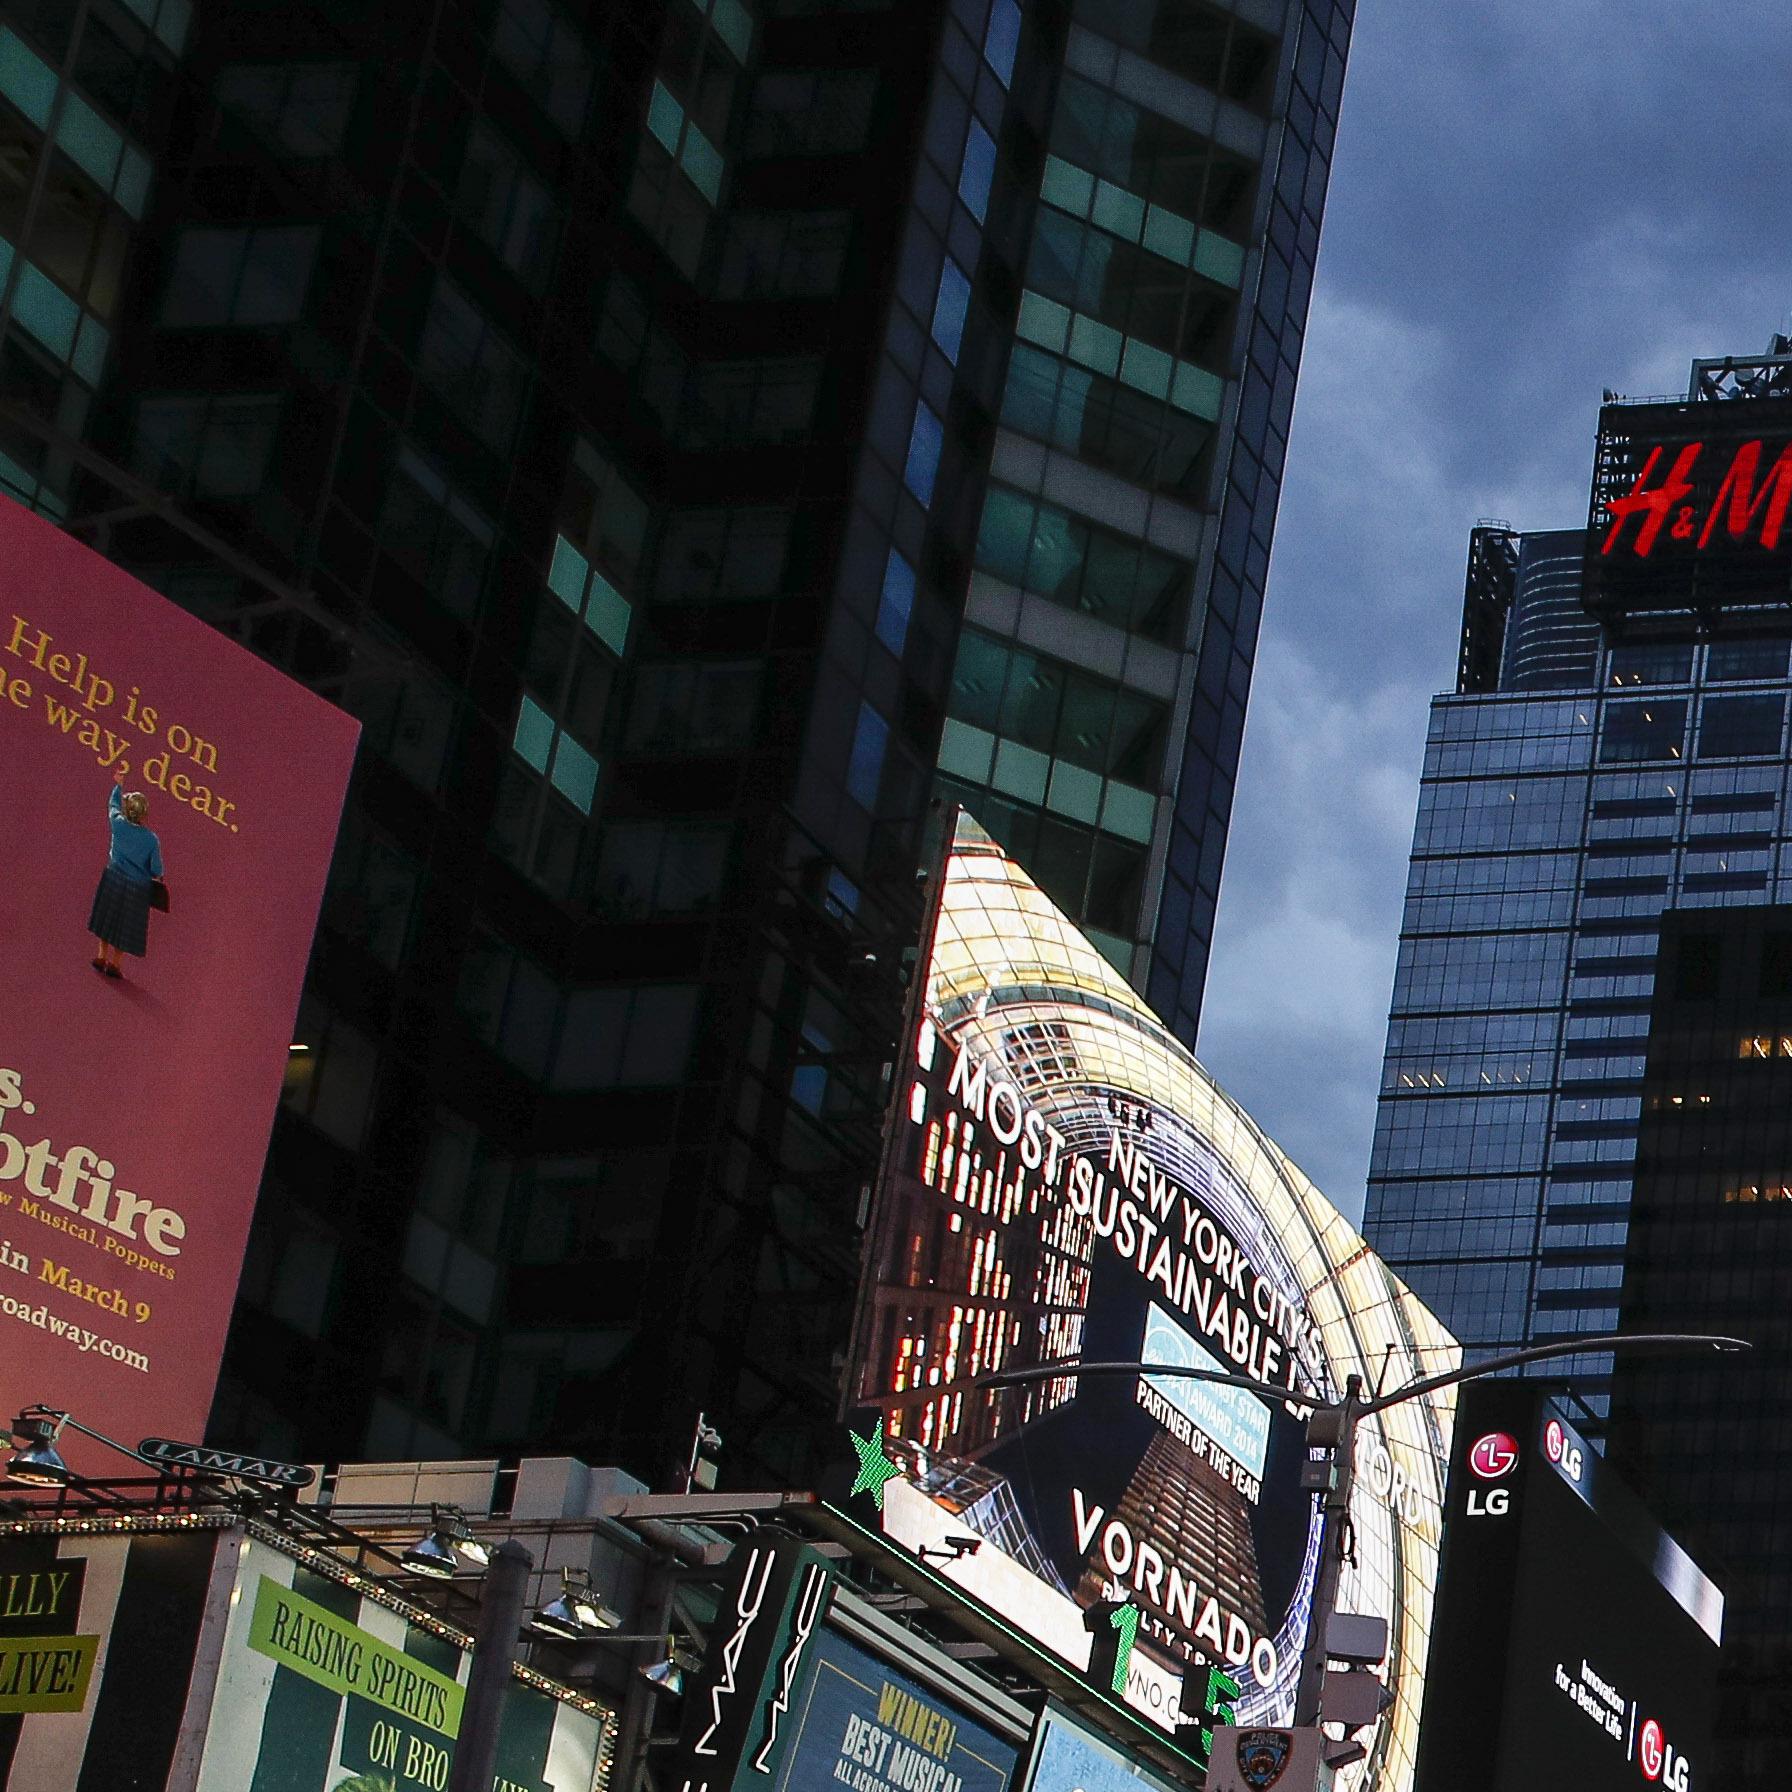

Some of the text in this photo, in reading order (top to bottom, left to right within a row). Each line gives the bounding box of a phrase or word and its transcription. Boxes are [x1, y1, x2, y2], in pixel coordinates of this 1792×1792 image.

[5, 614, 219, 775] Help is on
[143, 751, 240, 833] dear.
[949, 1036, 1283, 1387] MOST SUSTAINABLE
[1107, 1127, 1251, 1299] NEW YORK
[38, 1257, 152, 1325] March 9
[1136, 1381, 1189, 1448] PARTNER
[154, 1441, 298, 1480] LAMAR
[1467, 1489, 1510, 1517] LG
[1072, 1488, 1277, 1689] VORNADO
[271, 1601, 448, 1729] RAISING SPIRITS
[1554, 1662, 1623, 1741] for Life
[1581, 1658, 1625, 1716] Innovation
[369, 1720, 400, 1770] ON
[841, 1712, 893, 1774] BEST
[876, 1680, 958, 1763] WINNER!
[833, 1757, 853, 1786] ALL
